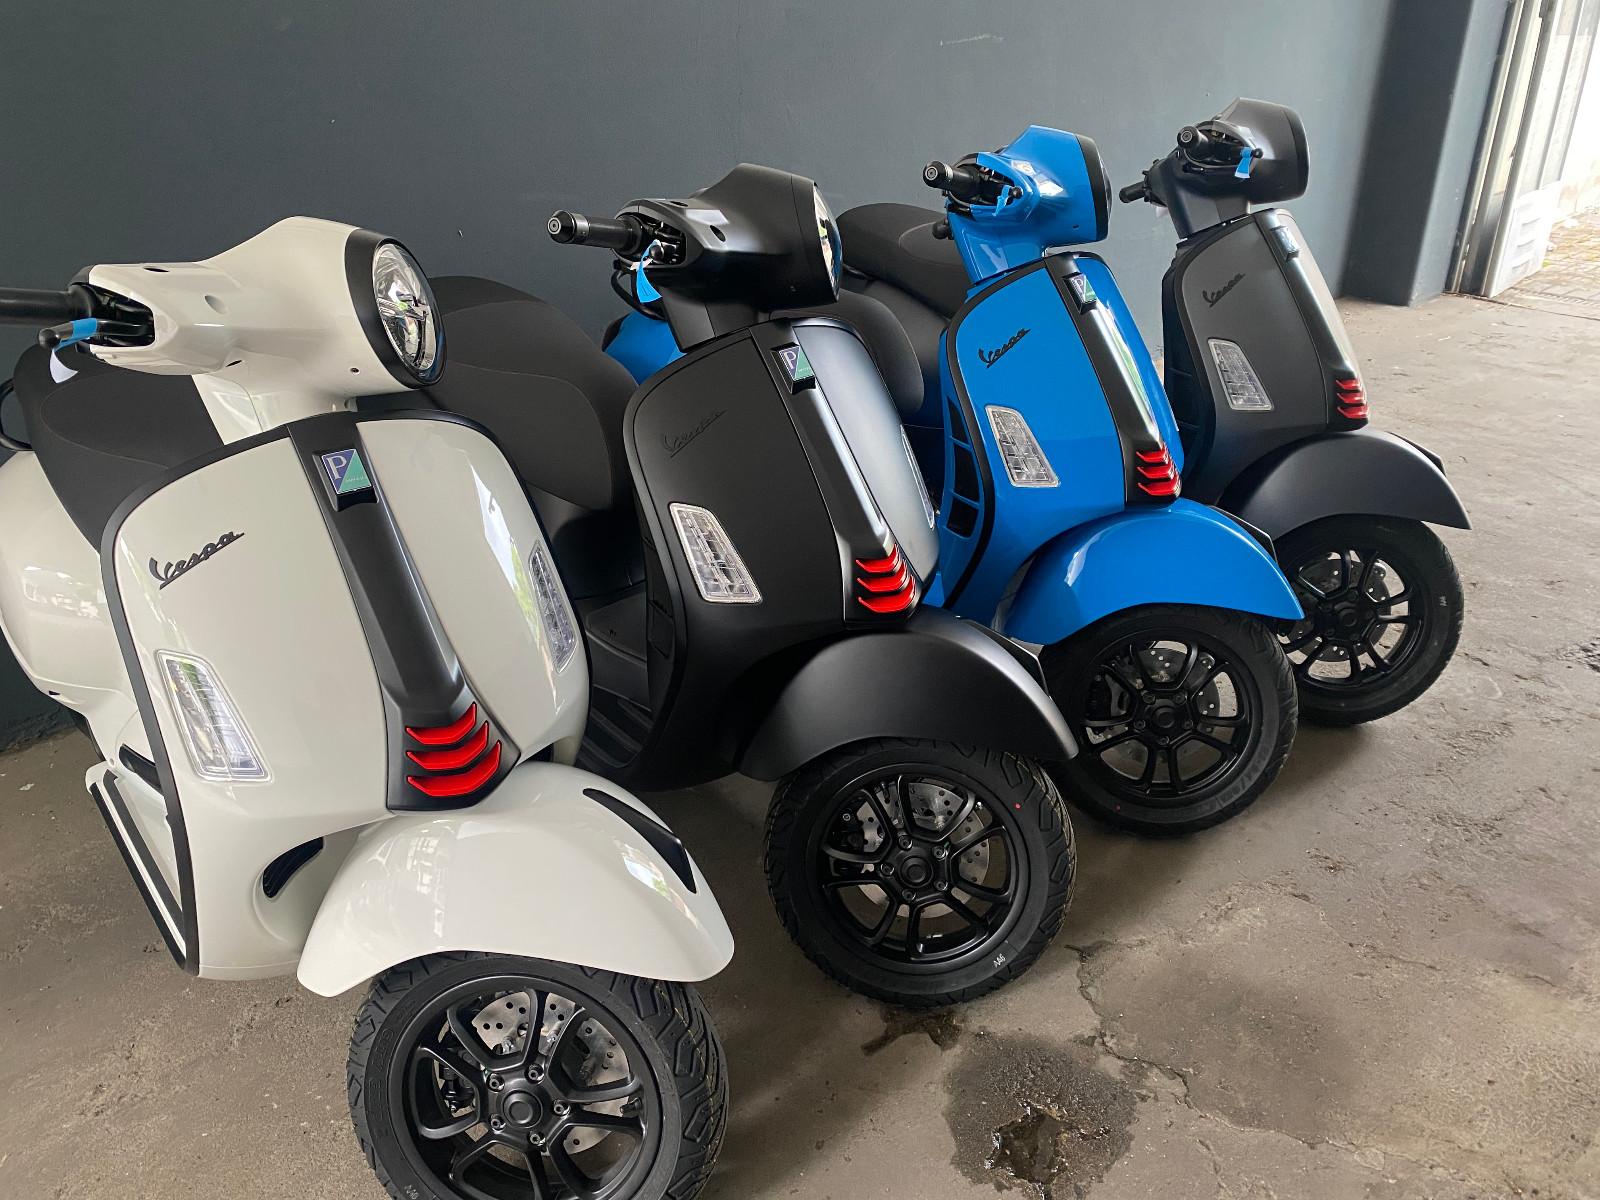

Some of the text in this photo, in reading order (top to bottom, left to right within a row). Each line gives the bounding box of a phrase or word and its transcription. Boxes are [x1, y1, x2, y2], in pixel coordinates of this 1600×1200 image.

[1202, 273, 1246, 308] Vespa
[783, 350, 797, 370] P
[978, 328, 1031, 369] Vespa
[662, 408, 728, 458] Vespa
[326, 455, 347, 480] P
[148, 531, 245, 591] Vespa
